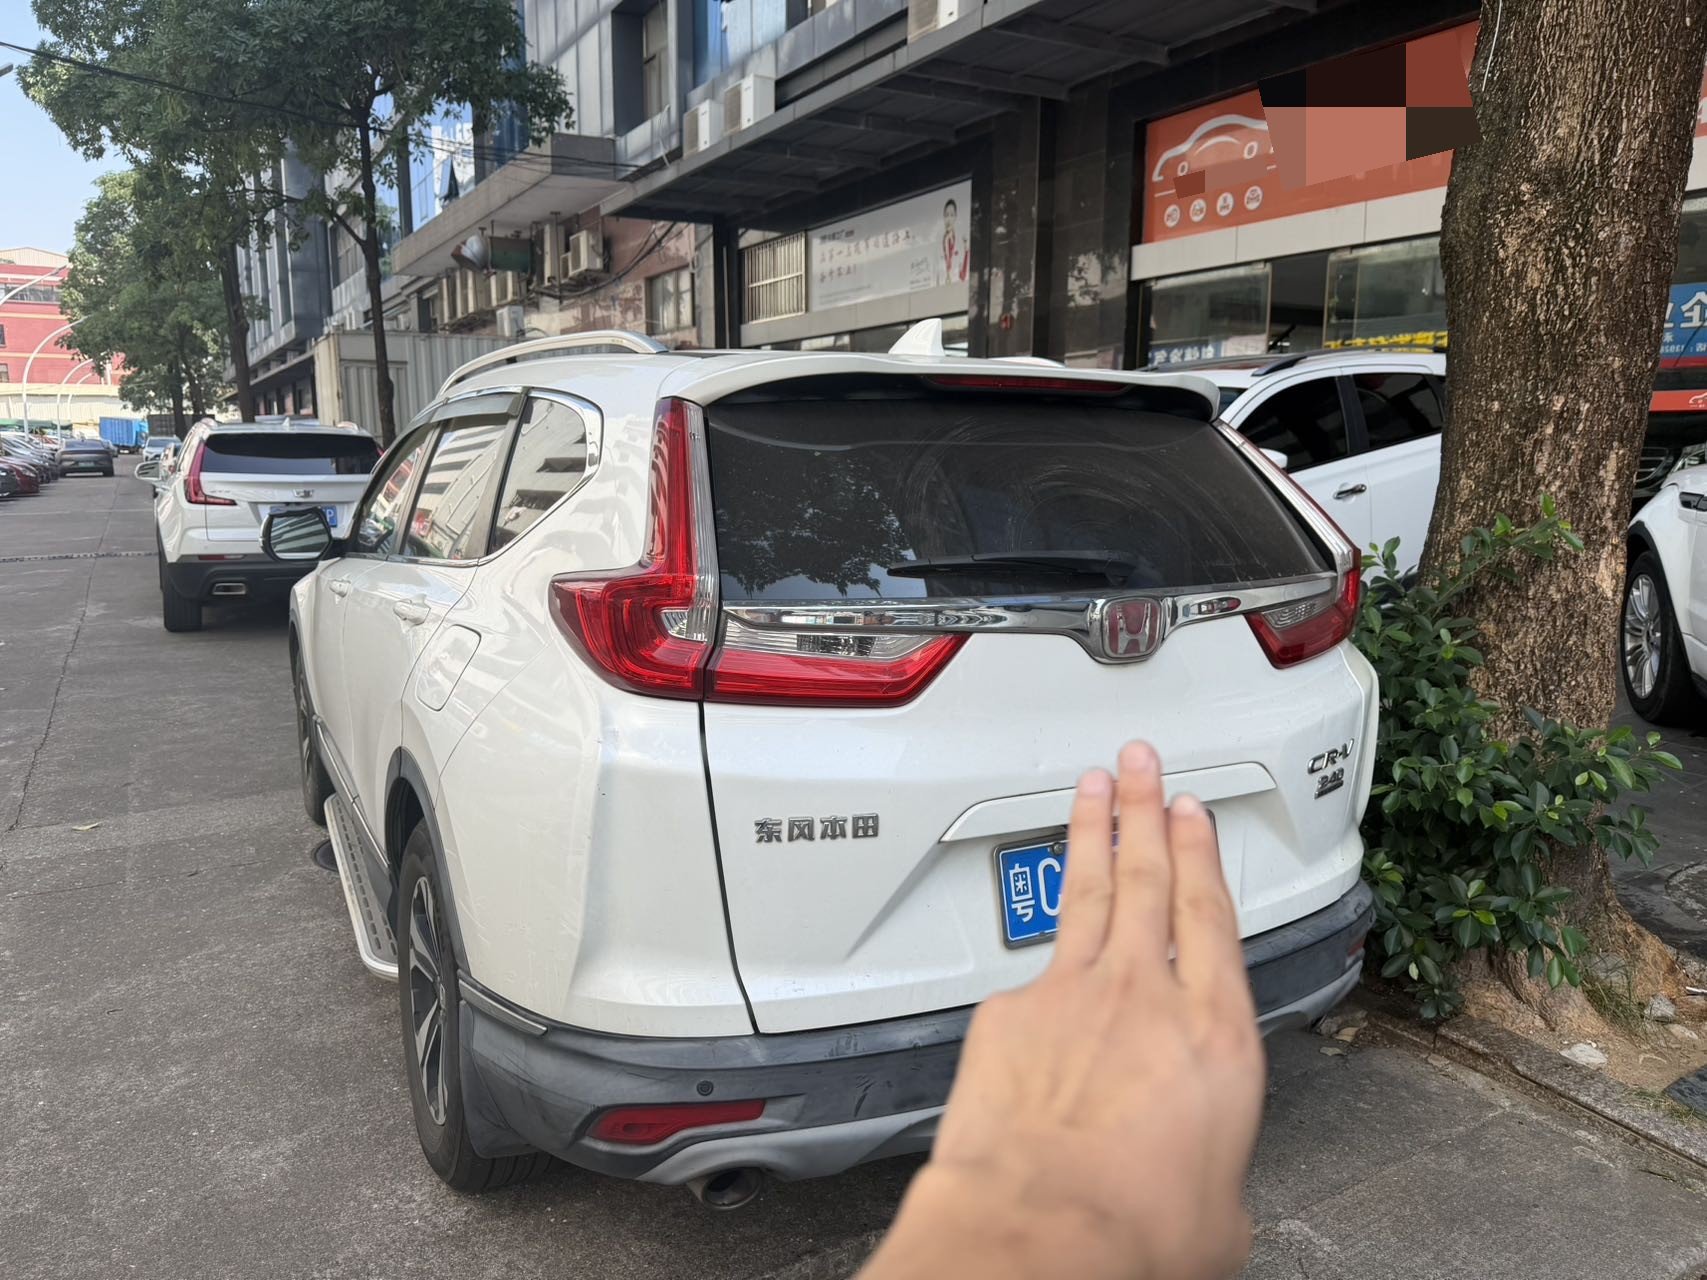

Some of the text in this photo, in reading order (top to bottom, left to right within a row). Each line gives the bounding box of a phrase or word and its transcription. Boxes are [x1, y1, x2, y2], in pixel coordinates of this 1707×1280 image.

[1308, 738, 1354, 774] CR-V
[754, 812, 880, 843] 东风本田
